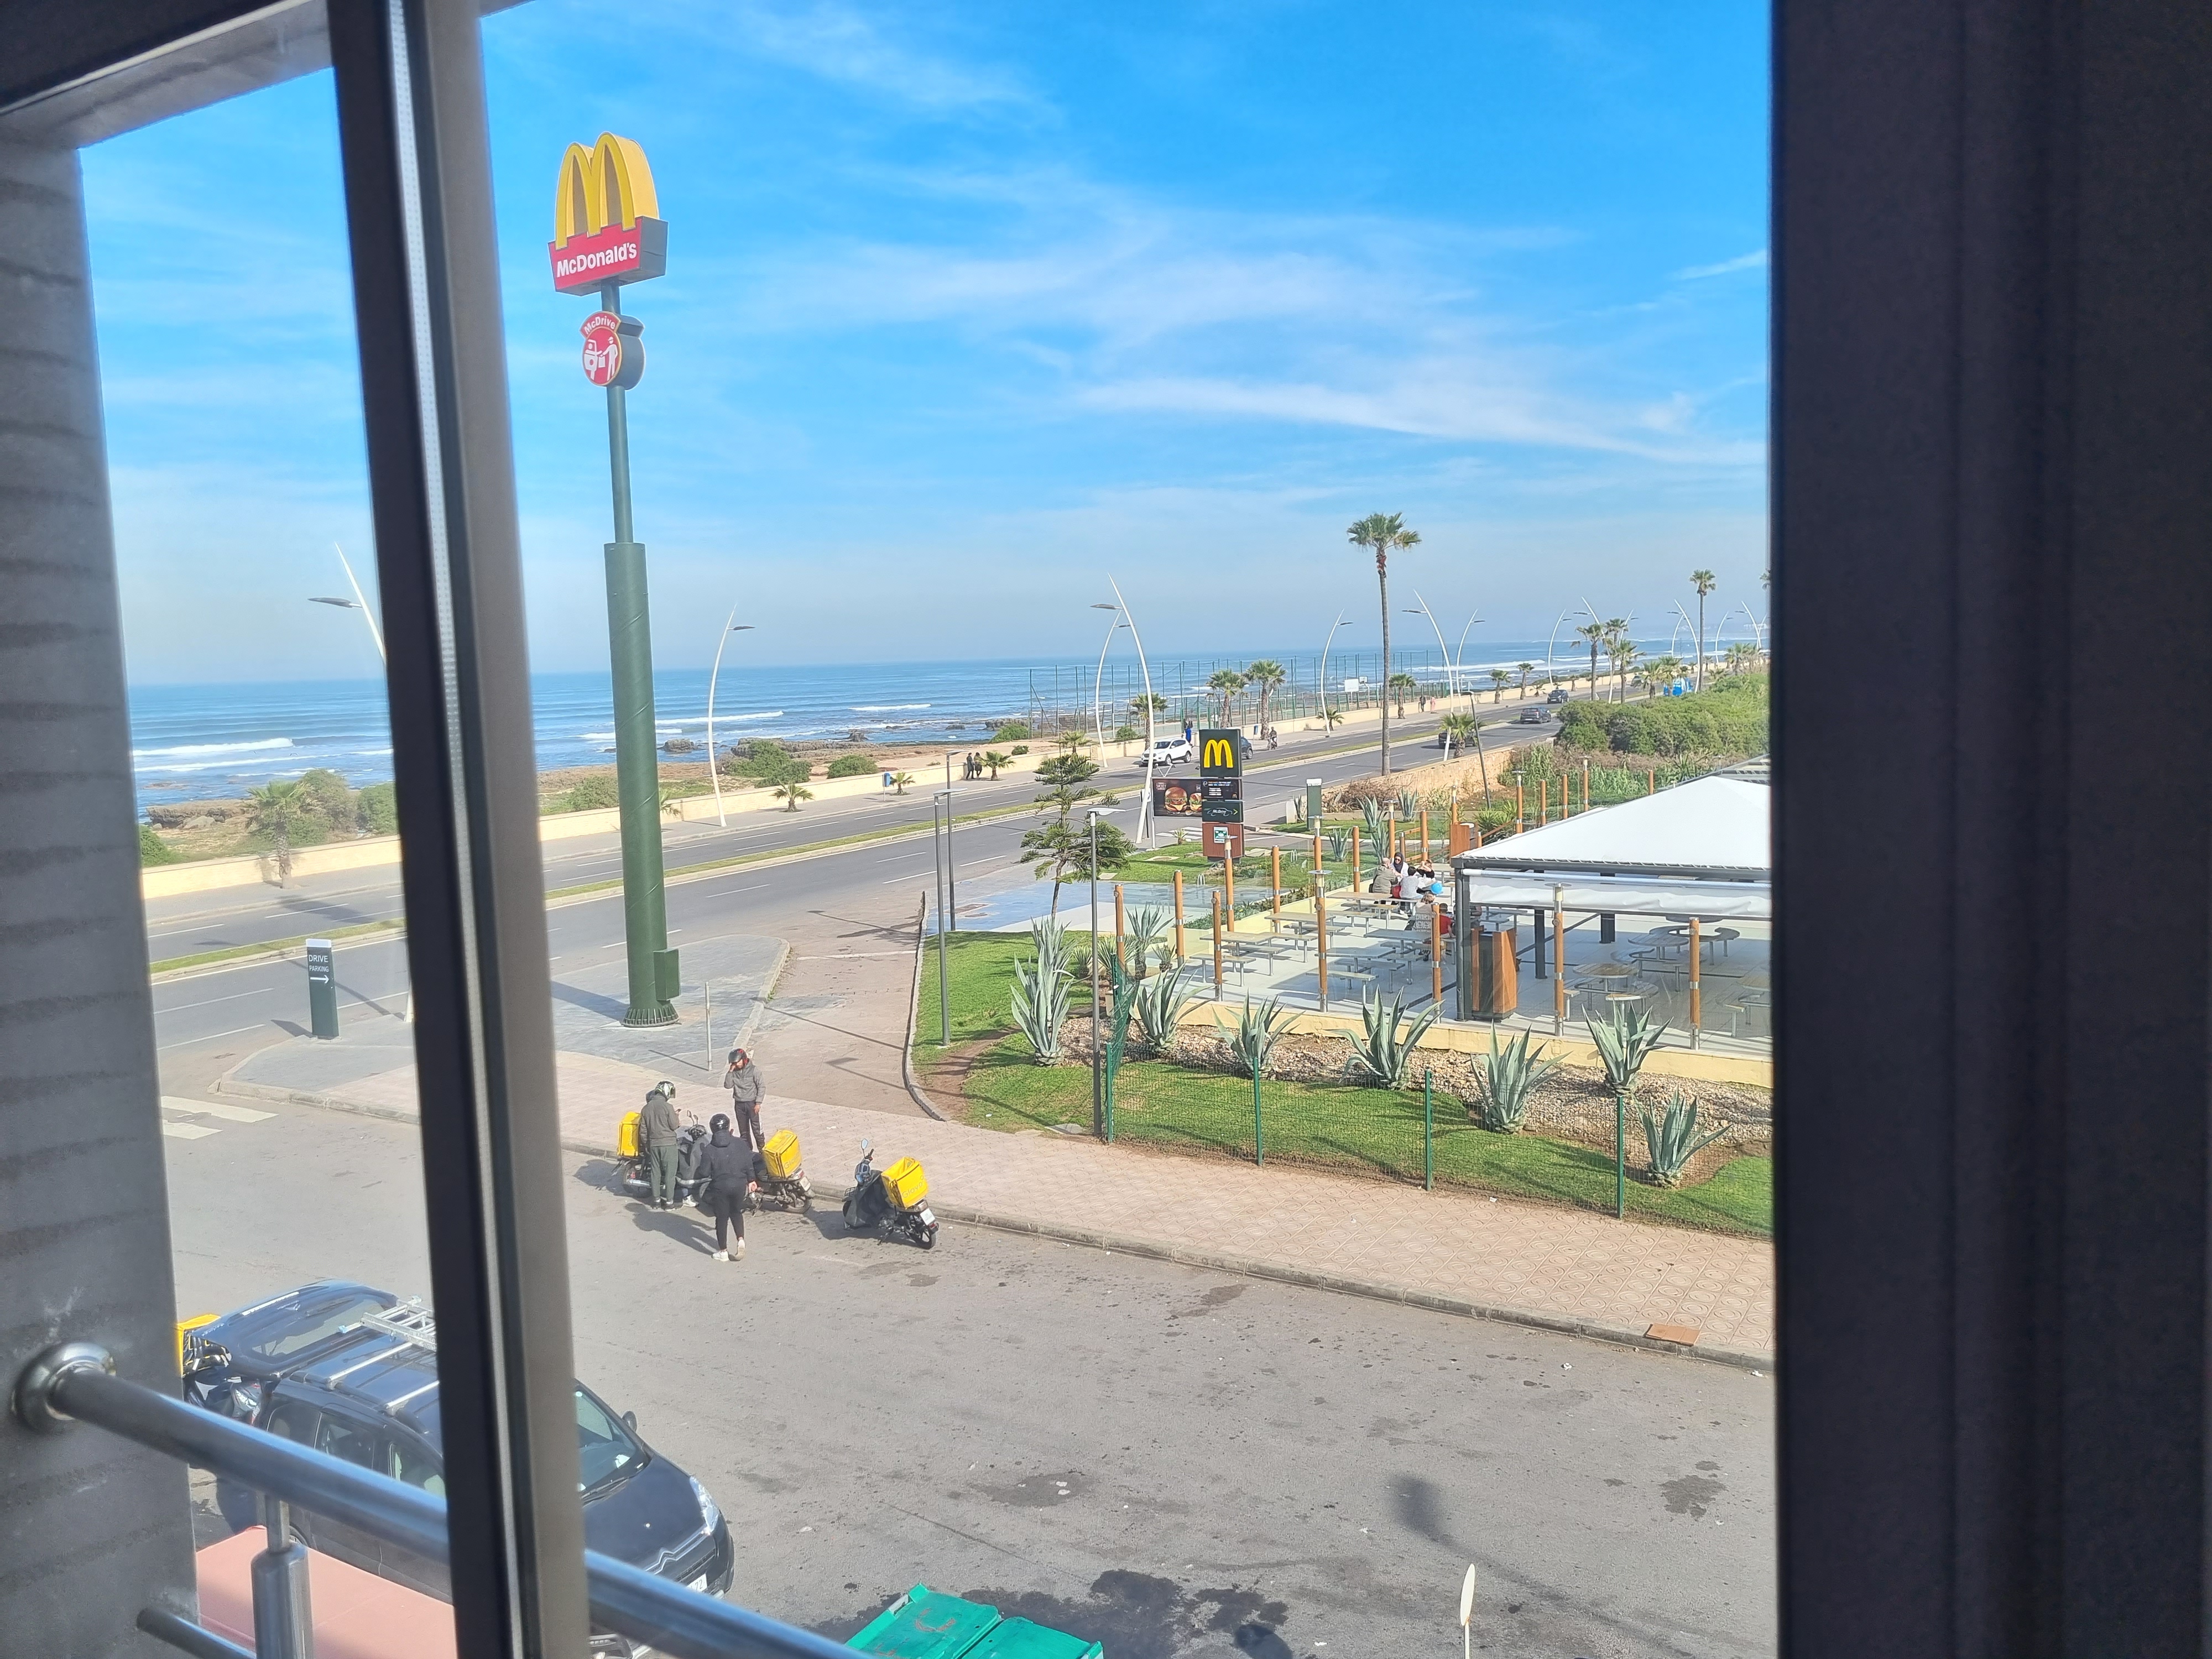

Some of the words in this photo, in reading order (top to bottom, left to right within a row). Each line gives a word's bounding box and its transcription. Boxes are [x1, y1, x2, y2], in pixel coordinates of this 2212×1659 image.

[557, 243, 637, 278] McDonald's
[584, 315, 615, 335] McDrive
[902, 1182, 923, 1198] Glovo
